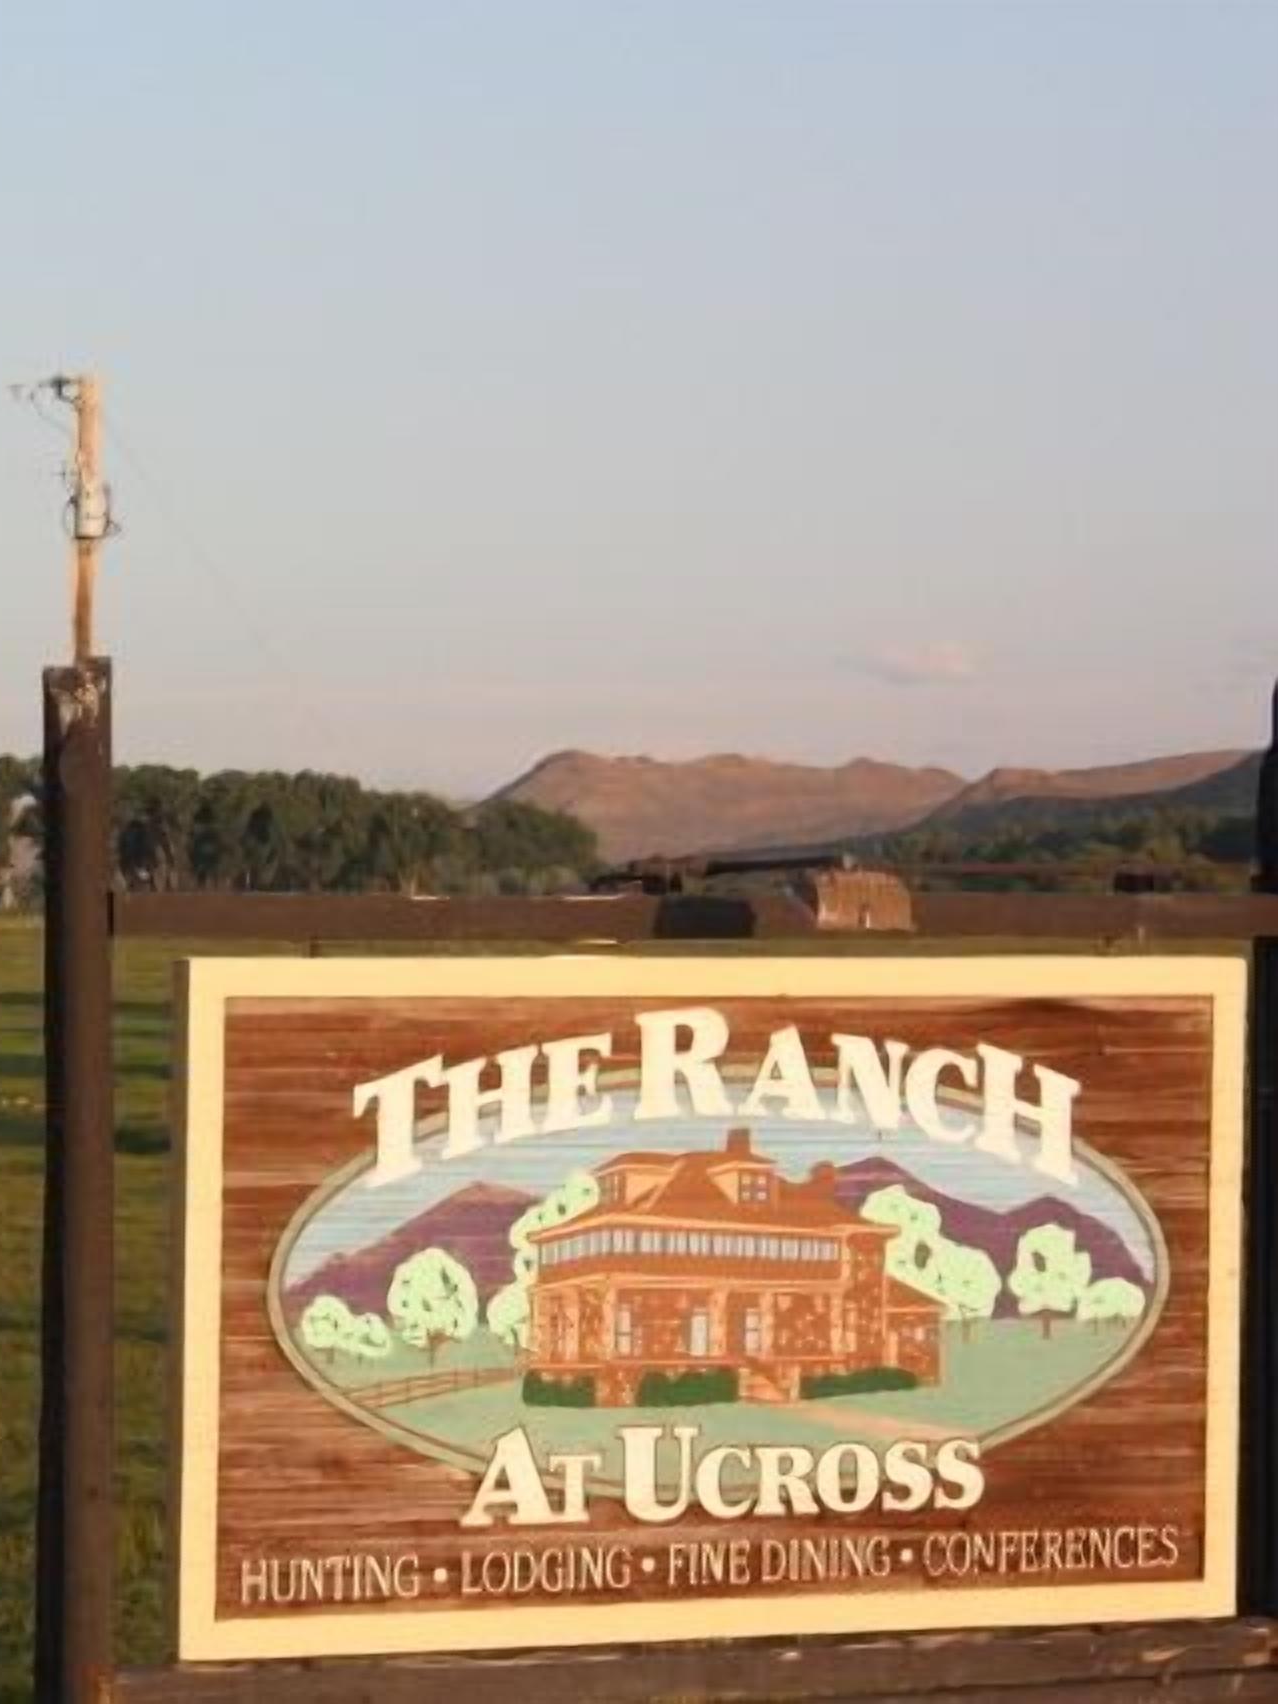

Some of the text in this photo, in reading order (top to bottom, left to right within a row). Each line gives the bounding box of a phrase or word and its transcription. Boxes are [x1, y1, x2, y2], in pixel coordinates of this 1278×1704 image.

[353, 1007, 1082, 1188] THE RANCH
[459, 1424, 986, 1527] AT UCROSS
[240, 1525, 1180, 1602] HUNTING LODGING FINE DINING CONFERENCES
